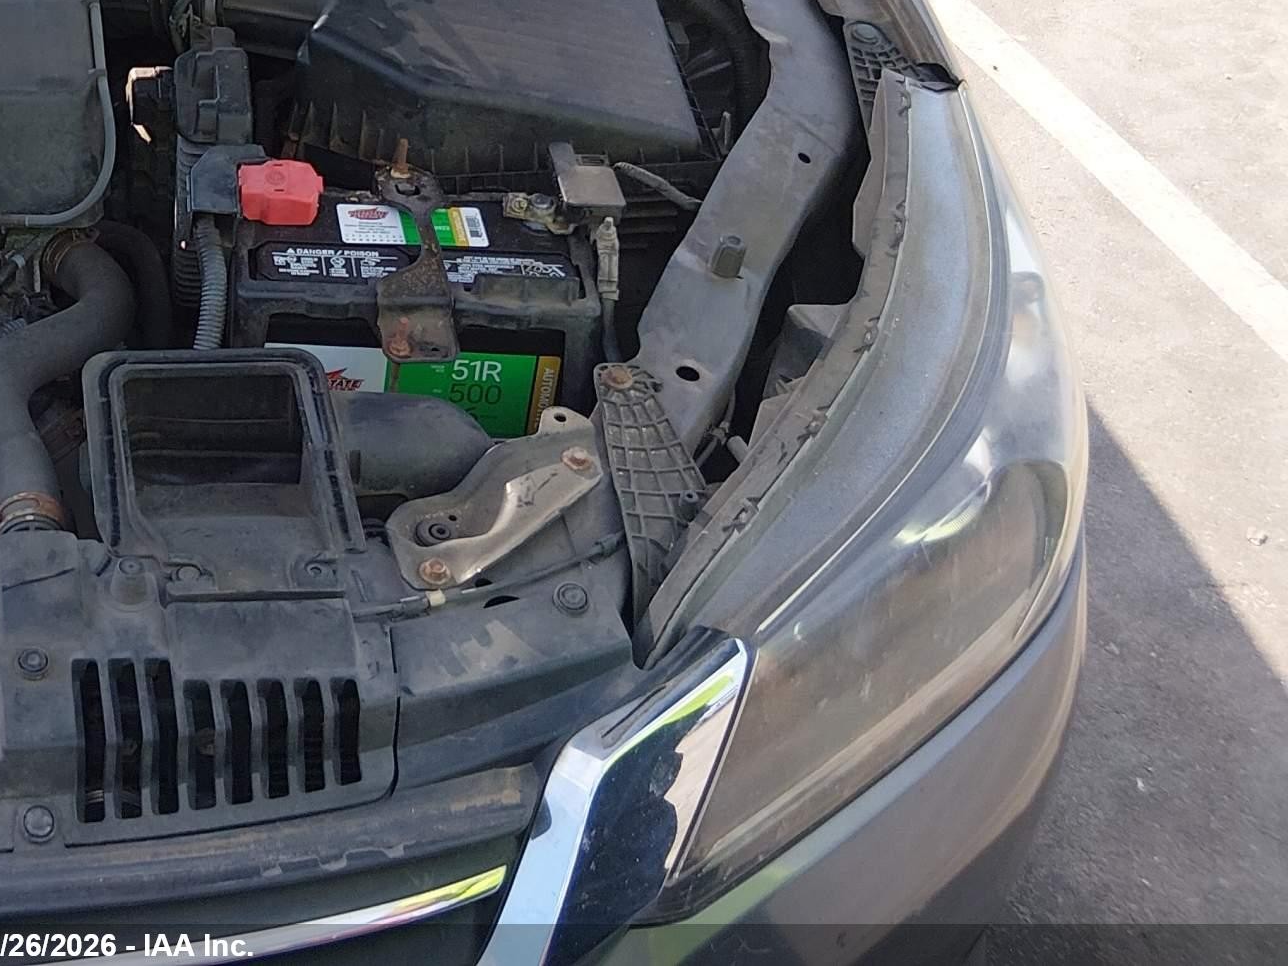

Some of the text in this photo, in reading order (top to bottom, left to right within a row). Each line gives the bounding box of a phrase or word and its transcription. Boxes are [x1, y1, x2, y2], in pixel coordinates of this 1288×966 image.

[296, 248, 335, 256] DANGER
[343, 249, 380, 258] POISON
[452, 359, 502, 382] 51R
[449, 383, 502, 405] 500
